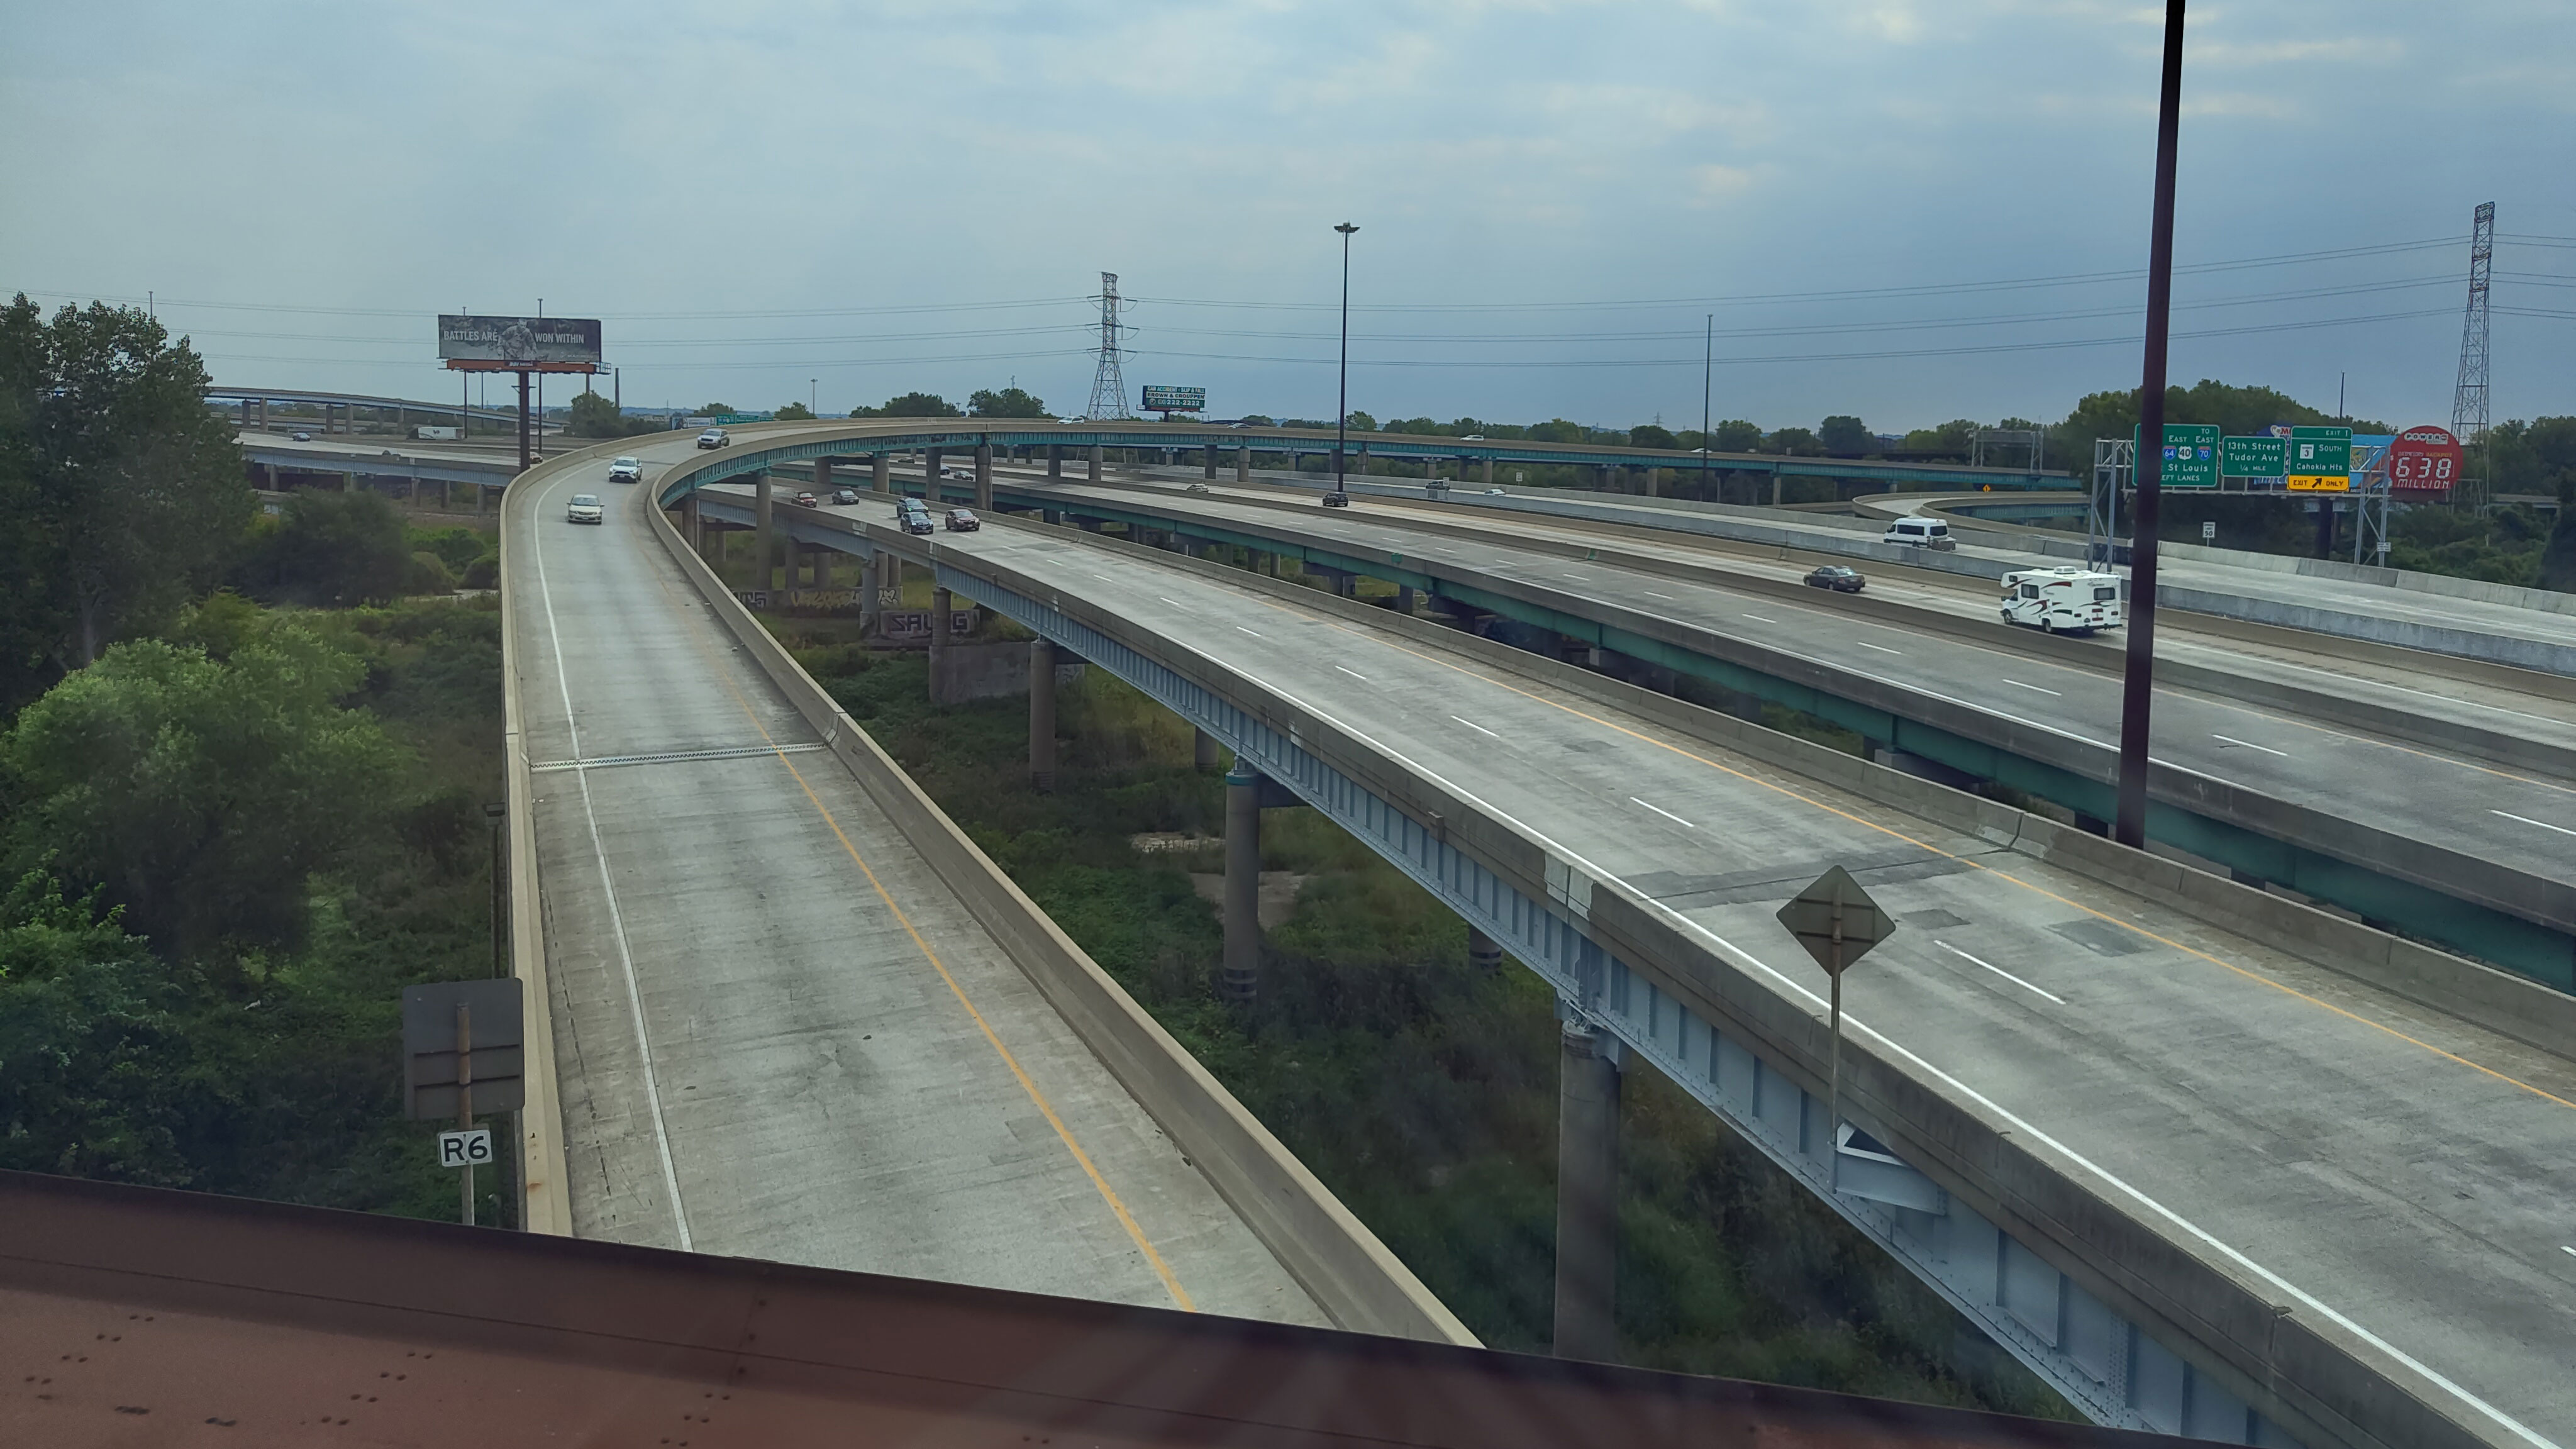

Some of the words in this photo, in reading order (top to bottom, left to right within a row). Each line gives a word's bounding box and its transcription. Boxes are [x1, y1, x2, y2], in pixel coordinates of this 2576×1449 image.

[443, 330, 480, 341] BATTLES
[481, 331, 497, 341] ARE
[535, 332, 553, 343] WON
[555, 333, 584, 343] WITHIN
[2228, 441, 2246, 450] 13th
[2251, 442, 2280, 451] Street
[2319, 444, 2342, 452] SOUTH
[2179, 449, 2190, 457] 40
[2229, 453, 2256, 461] Tudor
[2261, 453, 2279, 462] Ave
[2396, 457, 2452, 479] 638
[2397, 479, 2450, 489] MILLION
[443, 1136, 488, 1162] R6
